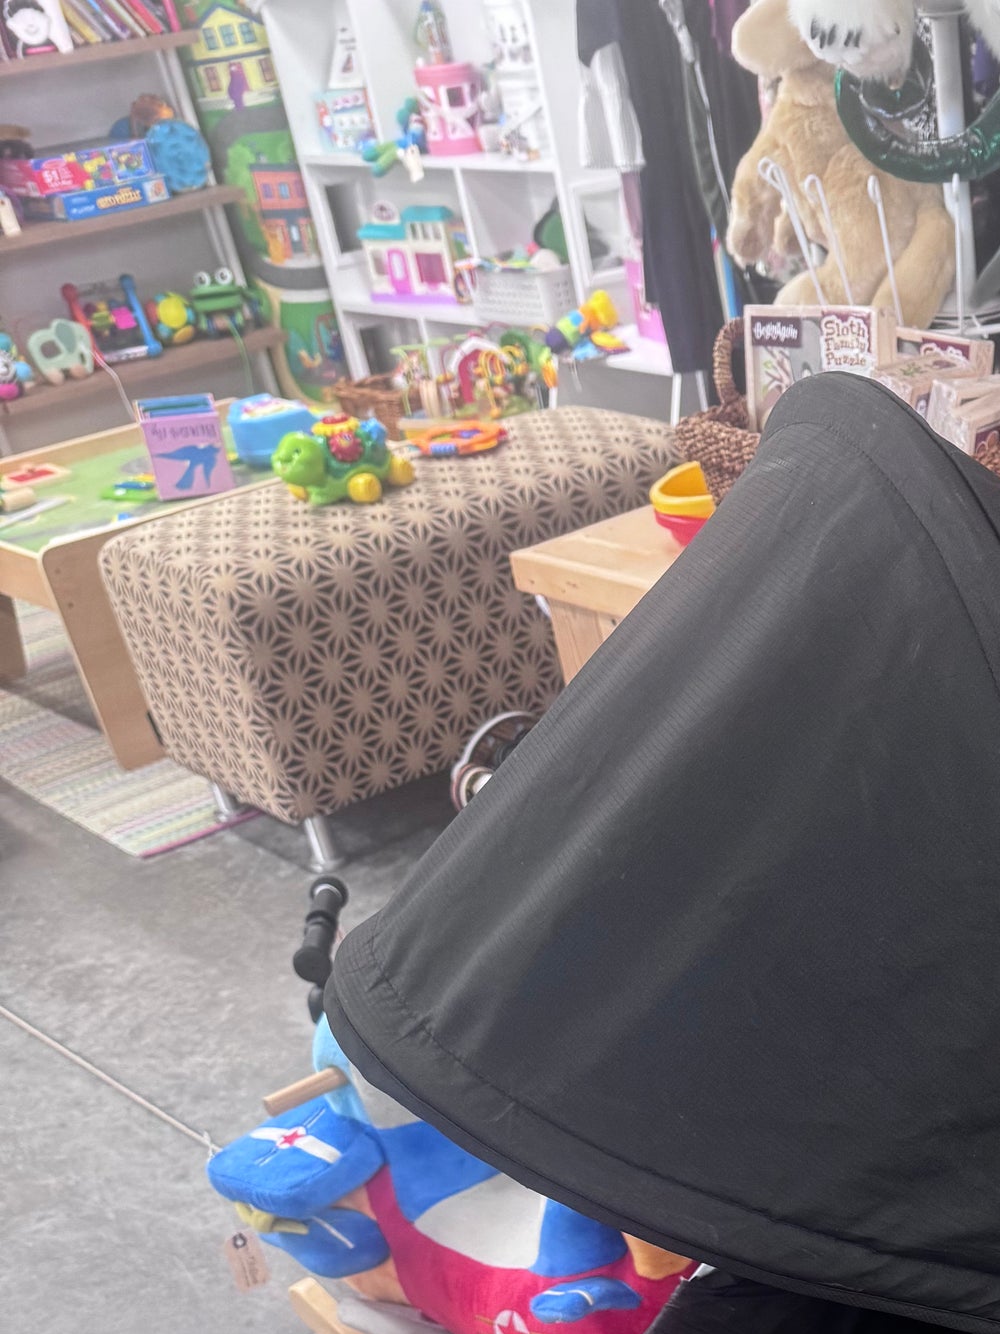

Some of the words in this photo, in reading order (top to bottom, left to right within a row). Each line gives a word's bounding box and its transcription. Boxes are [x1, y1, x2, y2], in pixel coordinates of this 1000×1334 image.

[824, 320, 865, 338] Sloth
[825, 337, 866, 353] Family
[826, 352, 866, 367] Puzzle
